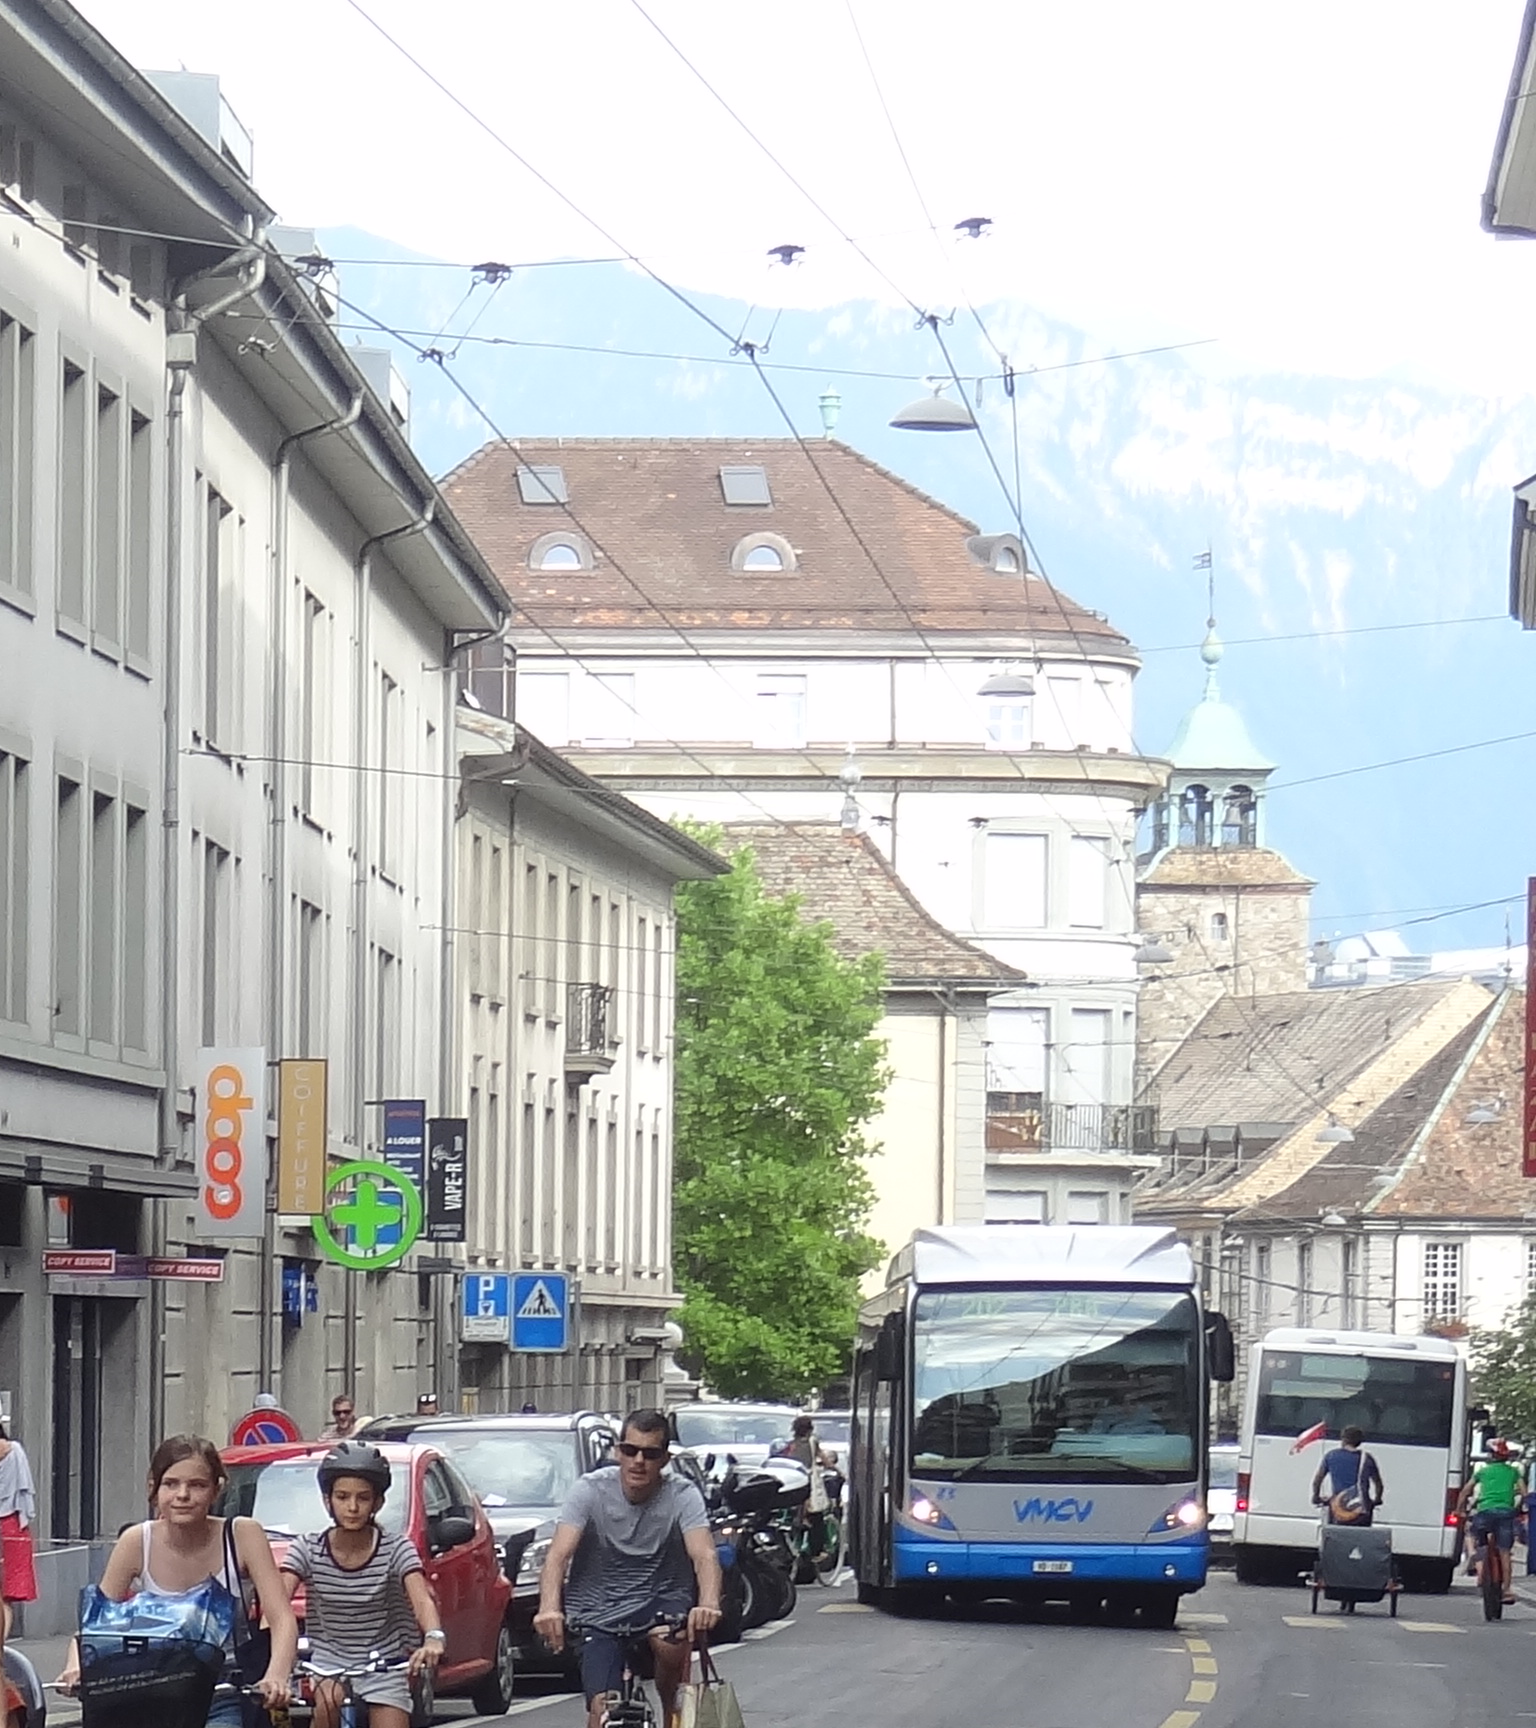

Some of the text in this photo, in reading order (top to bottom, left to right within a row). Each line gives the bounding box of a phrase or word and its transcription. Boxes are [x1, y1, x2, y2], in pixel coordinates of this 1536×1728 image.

[205, 1065, 254, 1220] coop
[293, 1067, 312, 1211] COIFFURE
[444, 1162, 463, 1210] VAPE-R
[74, 1257, 111, 1267] SERVICE
[176, 1265, 220, 1275] SERVICE
[479, 1276, 495, 1300] P
[1013, 1497, 1096, 1524] VMCV
